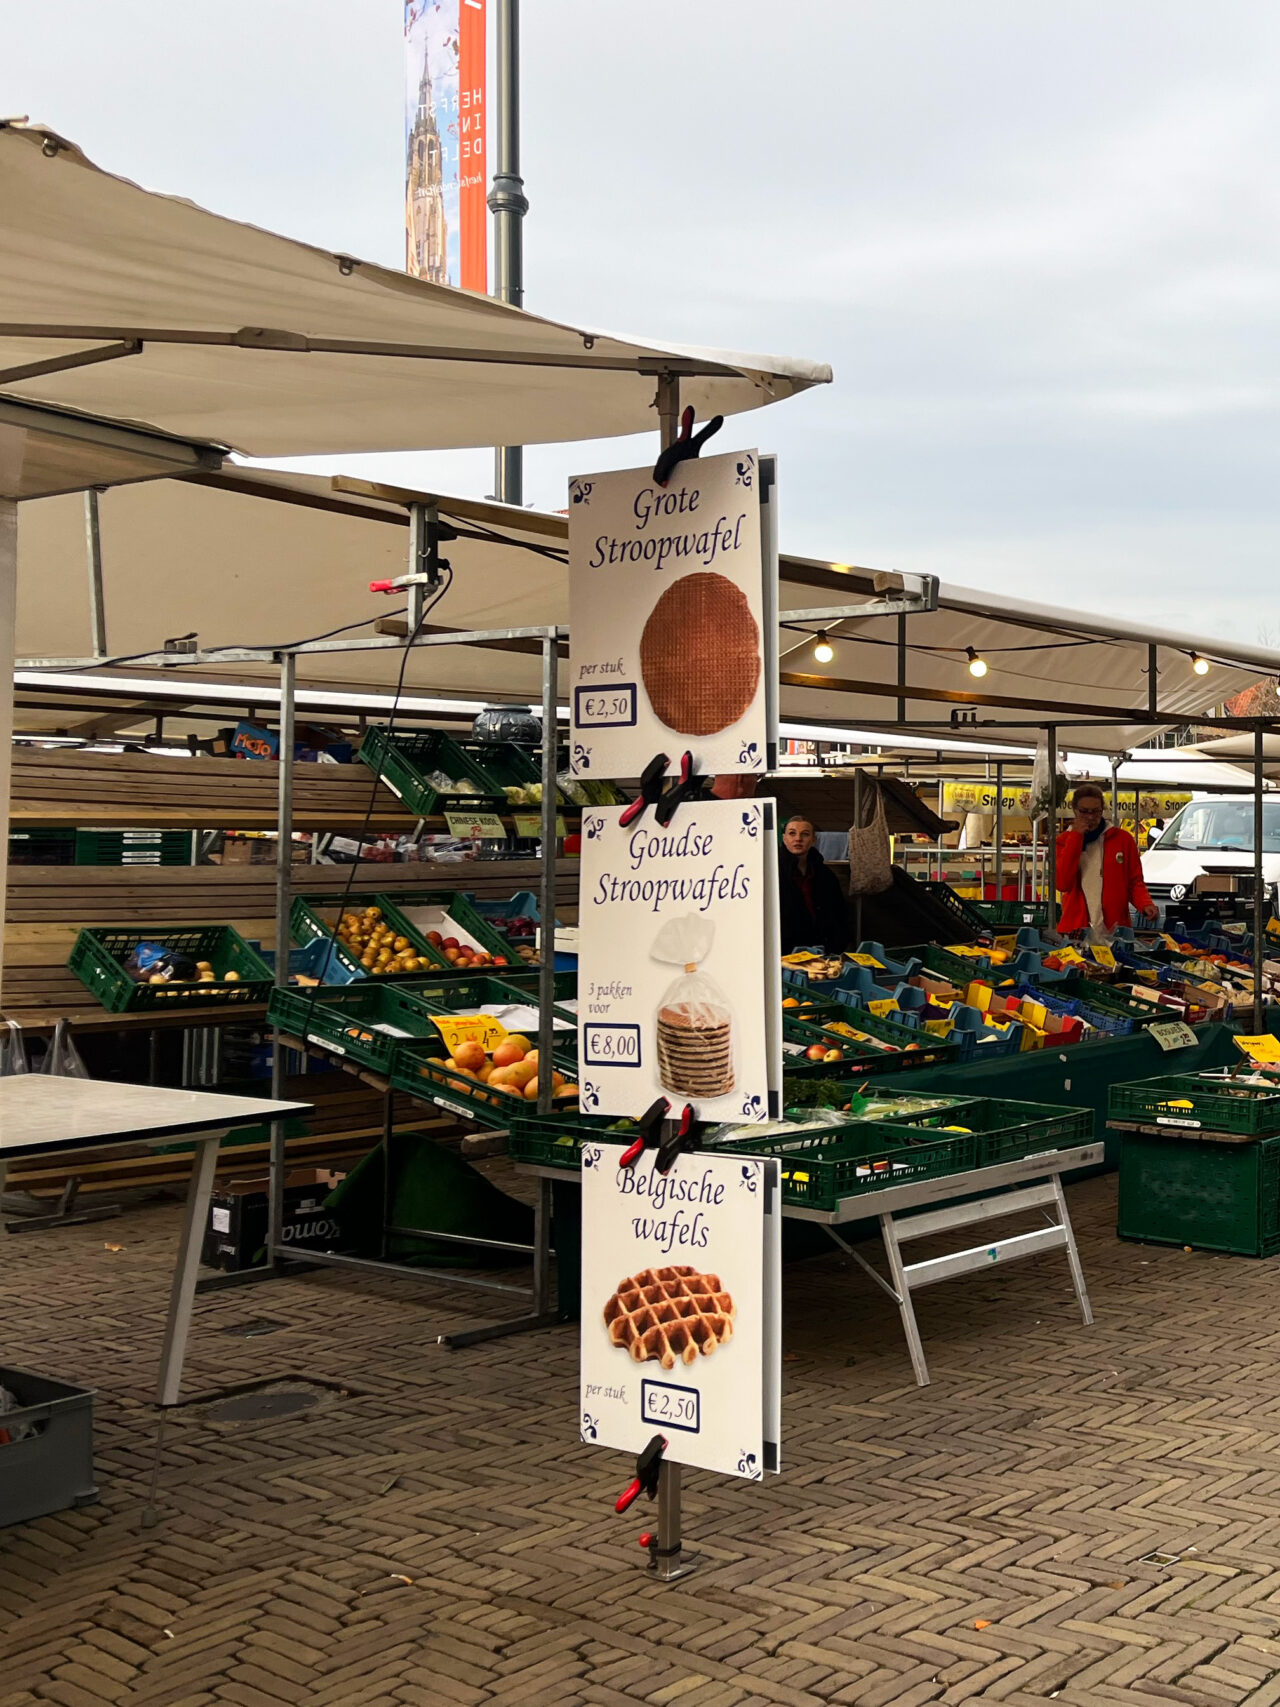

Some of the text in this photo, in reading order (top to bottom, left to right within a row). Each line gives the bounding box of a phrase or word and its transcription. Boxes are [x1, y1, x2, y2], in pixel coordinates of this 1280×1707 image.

[634, 486, 700, 530] Grote
[589, 513, 747, 571] Stroopwafel
[579, 657, 626, 680] per stuk
[585, 697, 628, 719] €2,50
[234, 733, 272, 756] MOJO
[982, 794, 1015, 810] Snep
[630, 822, 713, 871] Goudse
[593, 863, 751, 912] Stroopwafels
[588, 983, 632, 1001] 3 pakken
[588, 1002, 611, 1015] voor
[590, 1033, 636, 1059] €8,00
[616, 1165, 726, 1210] Belgische
[631, 1211, 710, 1254] wafels
[586, 1383, 628, 1405] per stuk
[647, 1391, 696, 1422] €2,50
